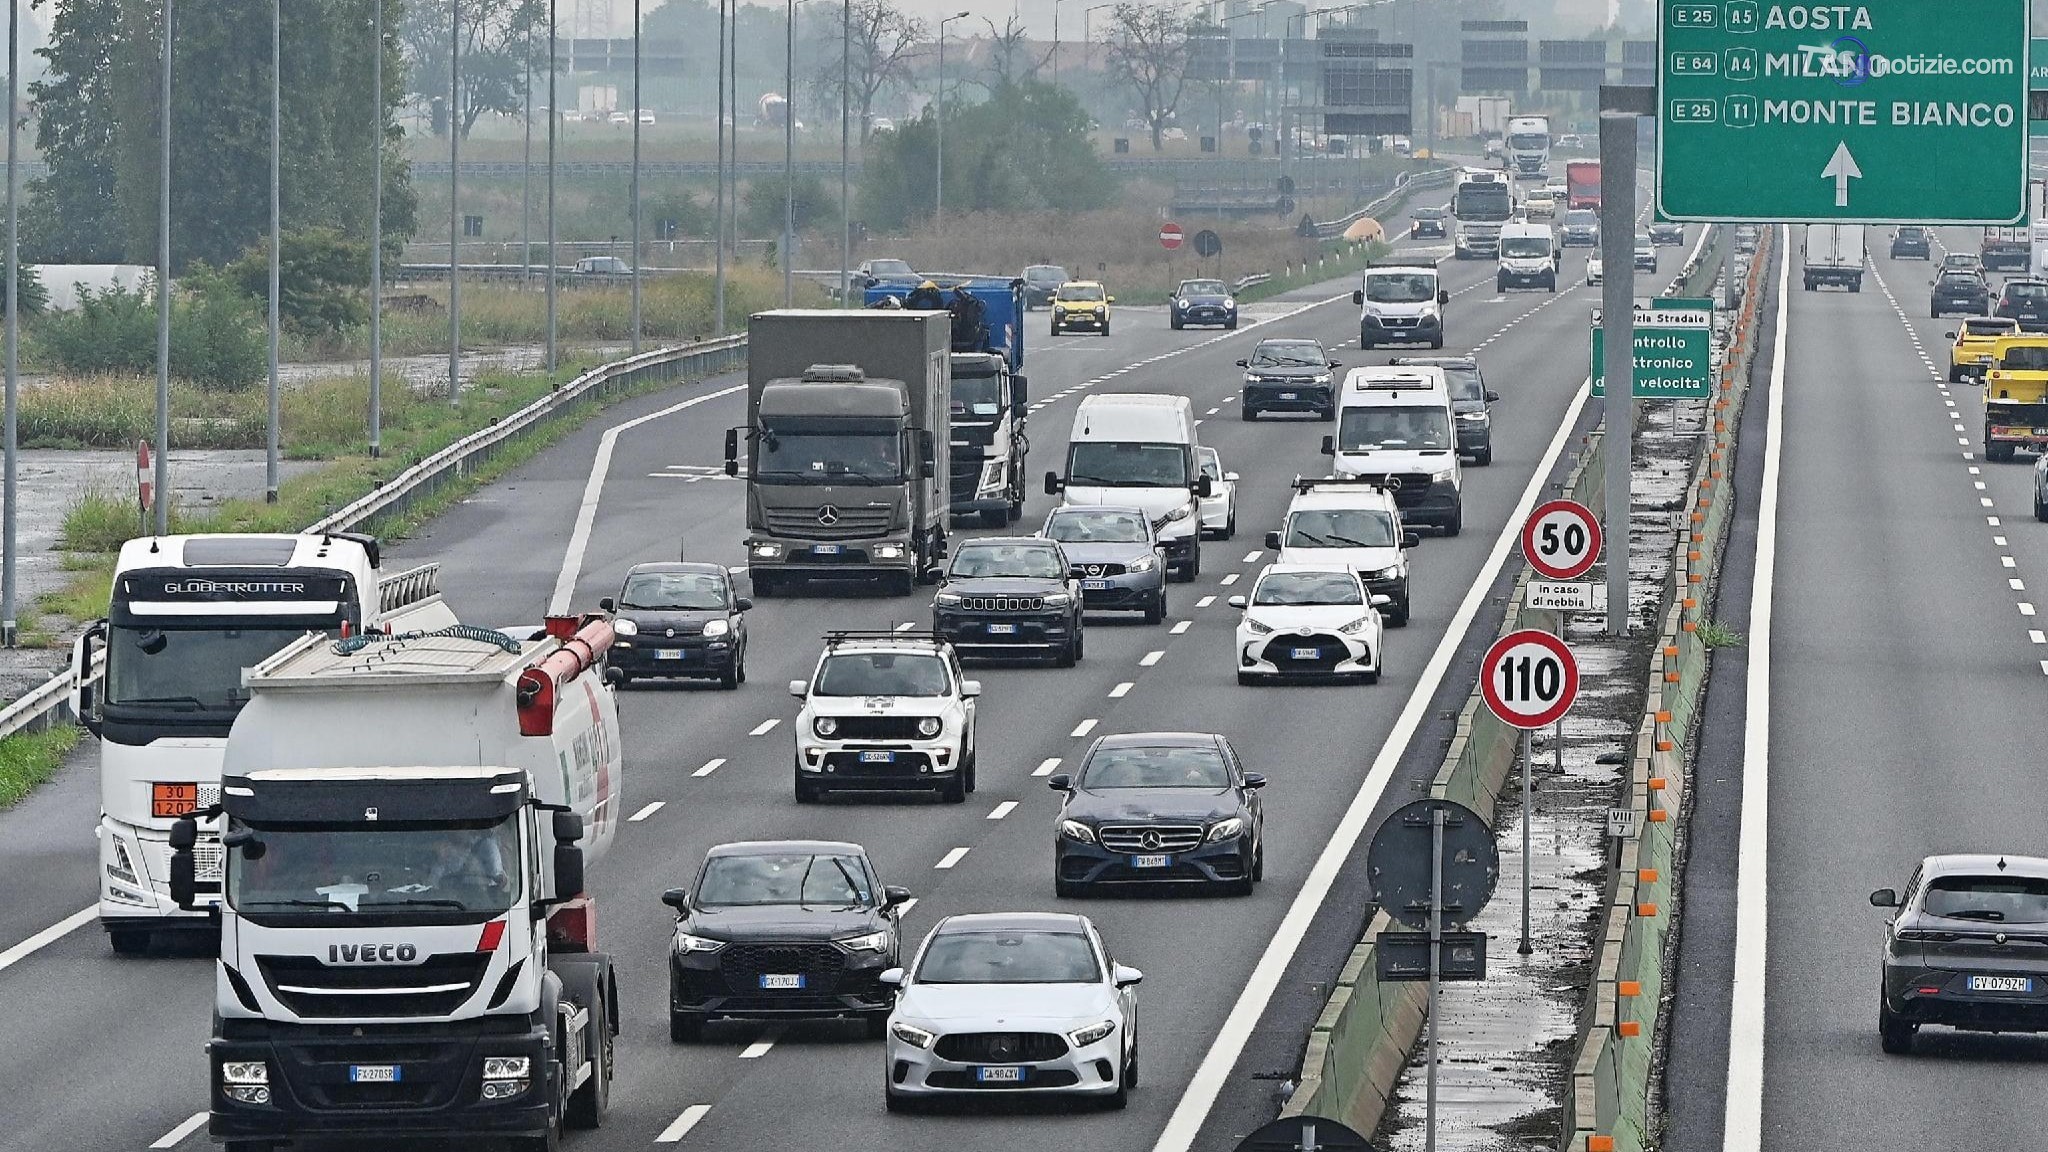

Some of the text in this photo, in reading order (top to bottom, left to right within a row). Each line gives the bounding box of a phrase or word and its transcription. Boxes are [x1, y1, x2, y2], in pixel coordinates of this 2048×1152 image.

[1678, 6, 1712, 23] E 25
[1764, 5, 1873, 30] AOSTA
[1677, 53, 1712, 70] E 64
[1765, 53, 1887, 78] MILANO
[1677, 105, 1711, 118] E 25
[1733, 104, 1749, 119] T1
[1763, 100, 2014, 127] MONTE BIANCO
[1657, 313, 1705, 323] Stradale
[1540, 523, 1585, 556] 50
[164, 582, 304, 593] GLOBETROTTER
[1539, 585, 1579, 594] in caso
[1532, 597, 1585, 607] di nebbia
[1500, 656, 1560, 701] 110
[166, 786, 184, 798] 30
[156, 802, 195, 815] 1202
[1612, 811, 1632, 822] VIII
[1618, 825, 1626, 834] 7
[328, 943, 417, 963] IVECO
